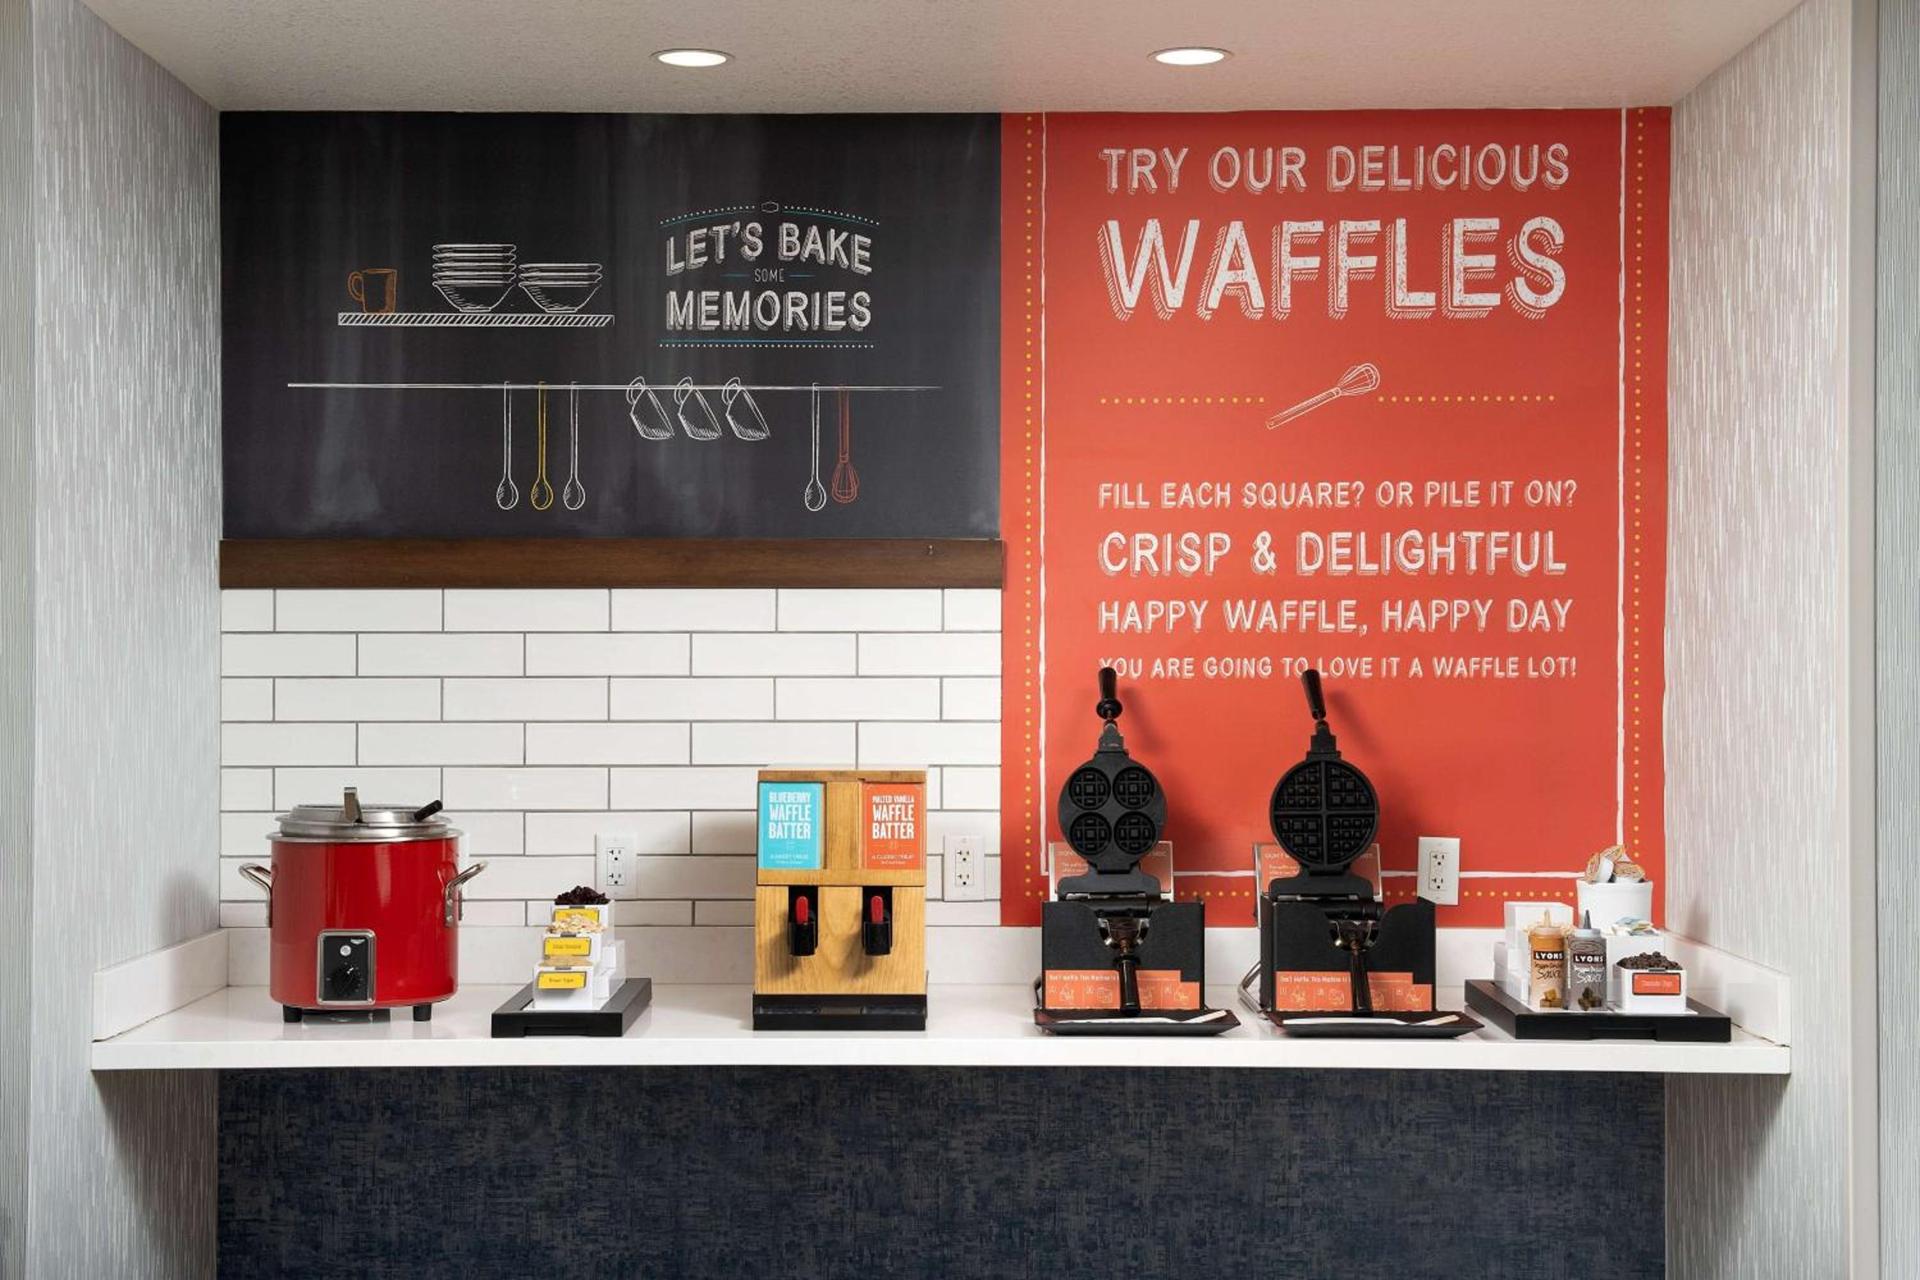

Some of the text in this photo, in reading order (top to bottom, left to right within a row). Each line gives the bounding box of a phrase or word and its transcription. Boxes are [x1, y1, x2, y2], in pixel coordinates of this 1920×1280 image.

[1099, 142, 1570, 194] TRY OUR DELICIOUS
[666, 220, 873, 276] LET'S BAKE
[754, 268, 785, 283] SOME
[1097, 215, 1567, 321] WAFFLES
[666, 289, 872, 332] MEMORIES
[1098, 478, 1578, 510] FILL EACH SQUARE? OR PILE IT ON?
[1098, 528, 1567, 578] CRISP & DELIGHTFUL
[1098, 598, 1574, 638] HAPPY WAFFLE, HAPPY DAY
[1150, 656, 1195, 679] ARE
[1203, 656, 1273, 679] GOING
[1280, 656, 1310, 679] TO
[1316, 656, 1374, 679] LOVE
[1380, 656, 1401, 679] IT
[1408, 656, 1424, 679] A
[1431, 656, 1520, 679] WAFFLE
[1527, 656, 1578, 679] LOT!
[768, 791, 812, 803] BLUEBERRY
[769, 803, 812, 821] WAFFLE
[872, 803, 915, 821] WAFFLE
[769, 822, 811, 839] BATTER
[872, 822, 915, 839] BATTER
[1535, 952, 1564, 960] LYONS
[1574, 955, 1604, 963] LYONS
